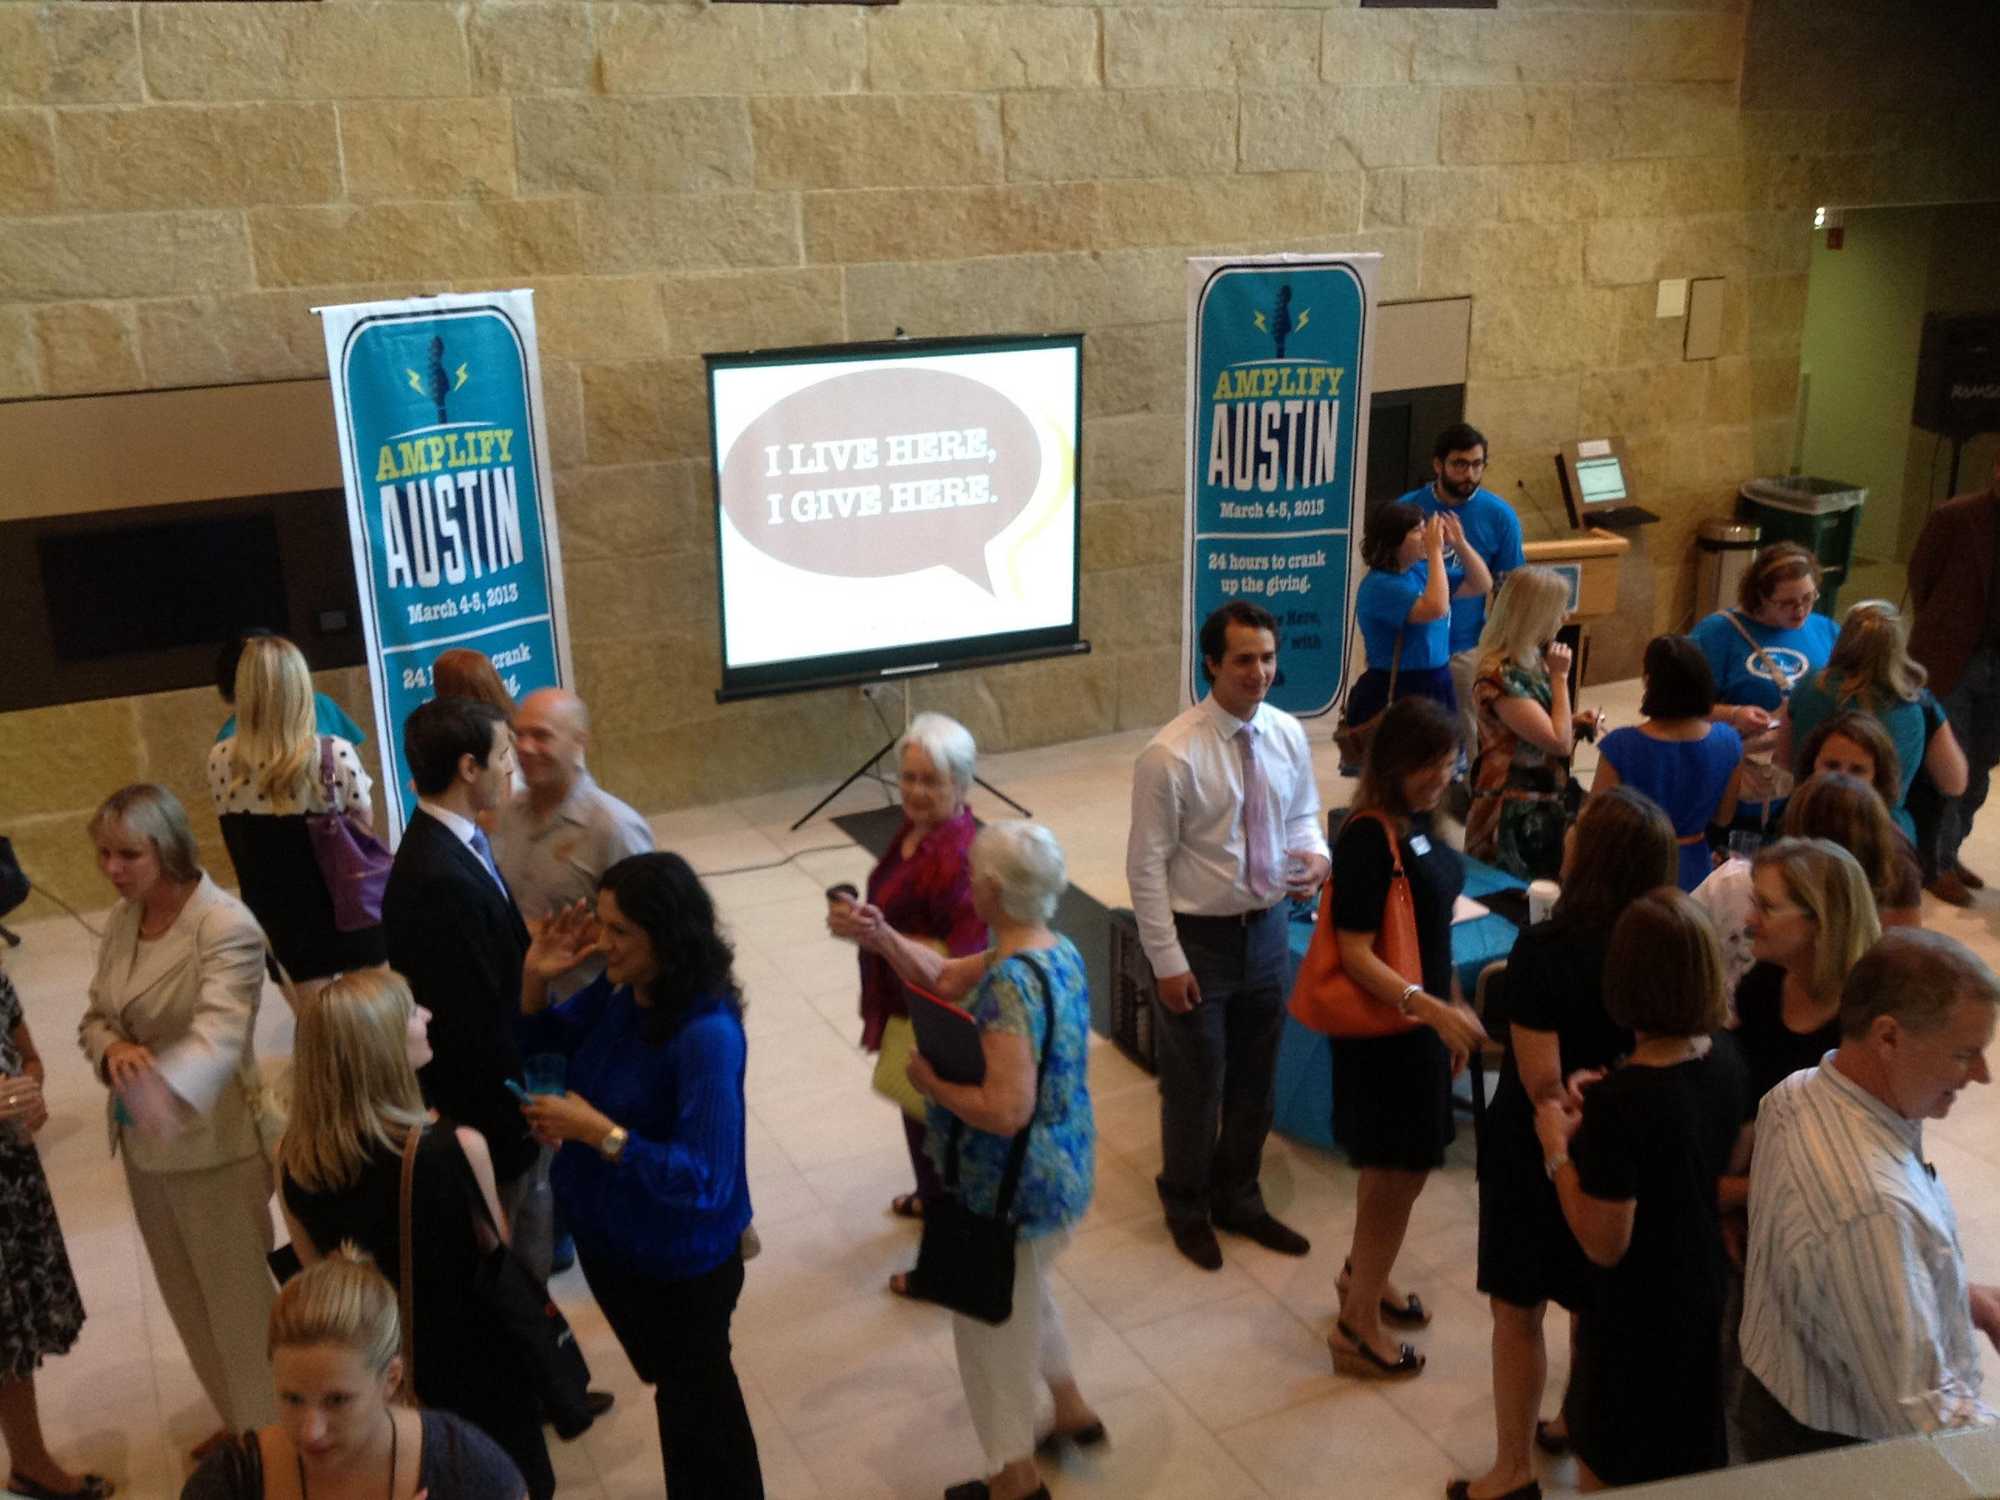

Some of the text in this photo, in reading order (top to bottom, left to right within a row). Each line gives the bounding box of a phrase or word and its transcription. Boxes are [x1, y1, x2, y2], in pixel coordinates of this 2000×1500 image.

[1212, 366, 1344, 400] AMPLIFY
[376, 428, 513, 482] AMPLIFY
[765, 427, 997, 477] I LIVE HERE,
[1207, 399, 1339, 492] AUSTIN
[767, 473, 999, 525] I GIVE HERE.
[1220, 502, 1264, 519] March
[379, 465, 524, 589] AUSTIN
[1208, 549, 1326, 570] 24 hours to crank
[408, 598, 458, 625] March
[486, 582, 519, 608] 2013
[1221, 574, 1312, 597] up the giving.
[492, 642, 533, 670] crank
[403, 665, 427, 690] 24
